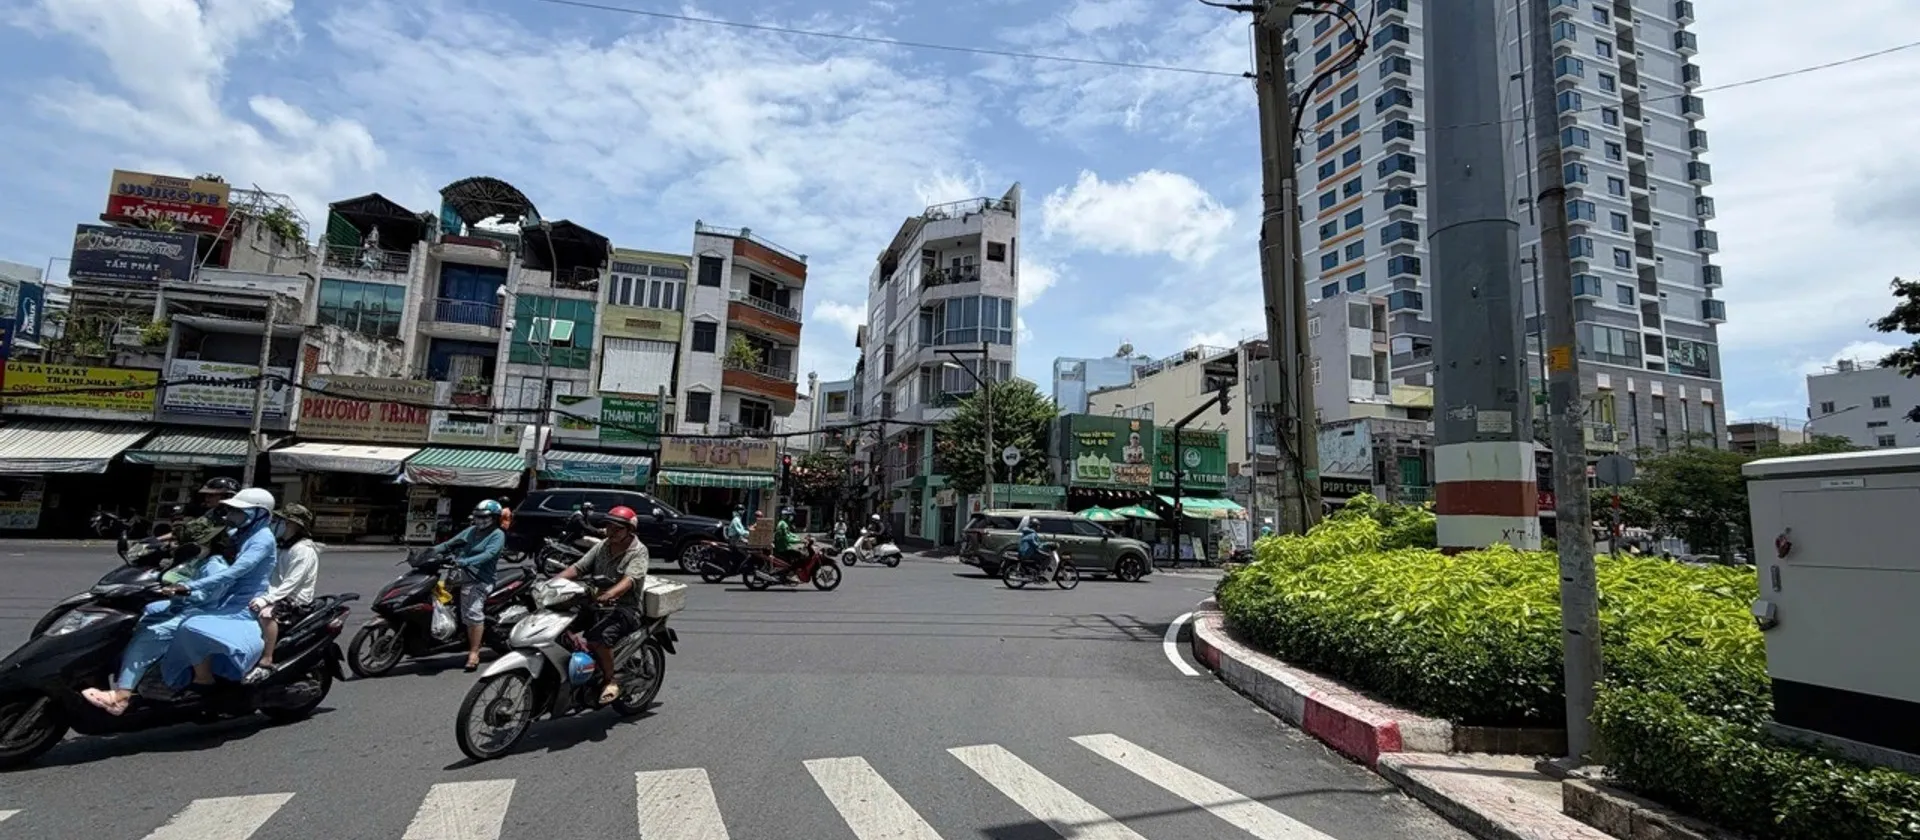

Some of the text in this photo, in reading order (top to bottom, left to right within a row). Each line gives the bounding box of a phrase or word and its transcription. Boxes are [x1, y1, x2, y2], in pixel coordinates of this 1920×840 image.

[27, 365, 43, 374] TA
[46, 367, 70, 377] TAM
[47, 376, 83, 385] THANH
[603, 409, 635, 422] THANH
[691, 445, 749, 466] 181
[1323, 482, 1344, 492] PIPI
